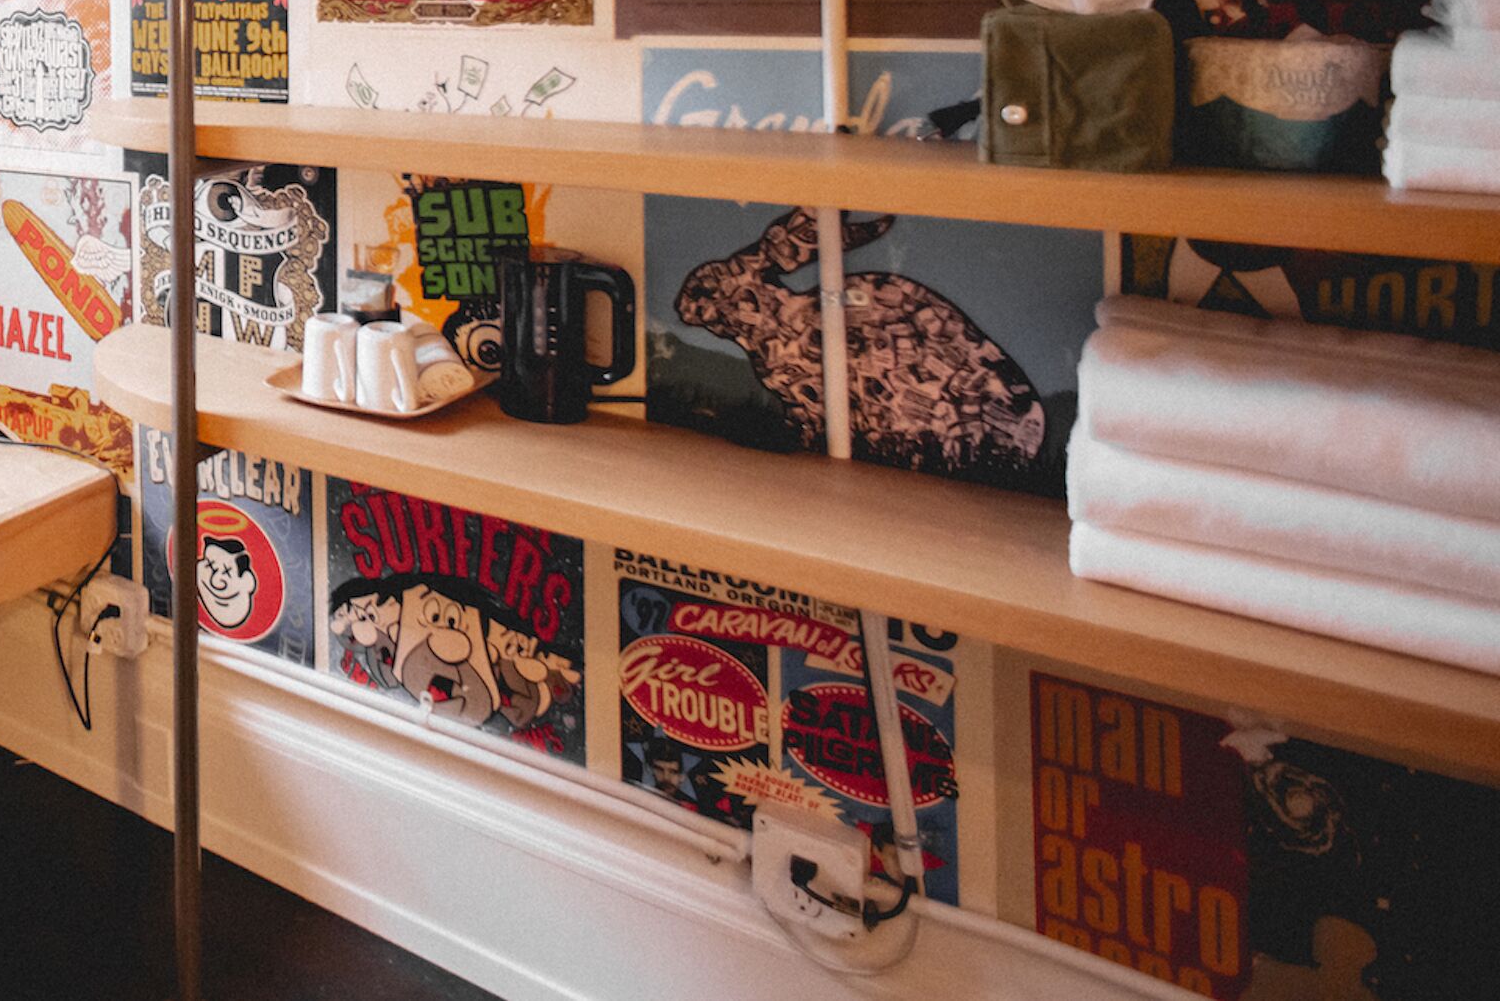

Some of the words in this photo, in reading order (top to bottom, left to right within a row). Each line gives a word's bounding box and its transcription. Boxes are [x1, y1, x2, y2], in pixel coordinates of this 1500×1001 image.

[145, 2, 165, 19] THE
[246, 20, 286, 54] 9th
[201, 52, 287, 82] BALLROOM
[1266, 62, 1342, 91] Angel
[418, 188, 528, 236] SUB
[206, 225, 298, 250] SEQUENCE
[15, 219, 115, 337] POND
[200, 282, 235, 309] ENIGK
[243, 303, 294, 323] SMOOSH
[147, 429, 300, 516] EVRCLEAR
[341, 486, 572, 642] SURFERS
[726, 589, 811, 618] OREGON
[674, 603, 818, 654] CARAVAN
[618, 646, 722, 696] Girl
[648, 679, 771, 744] TROUBLE
[1038, 681, 1184, 798] man
[764, 772, 802, 794] DOUBLE
[1039, 766, 1100, 840] or
[1041, 833, 1240, 977] astro
